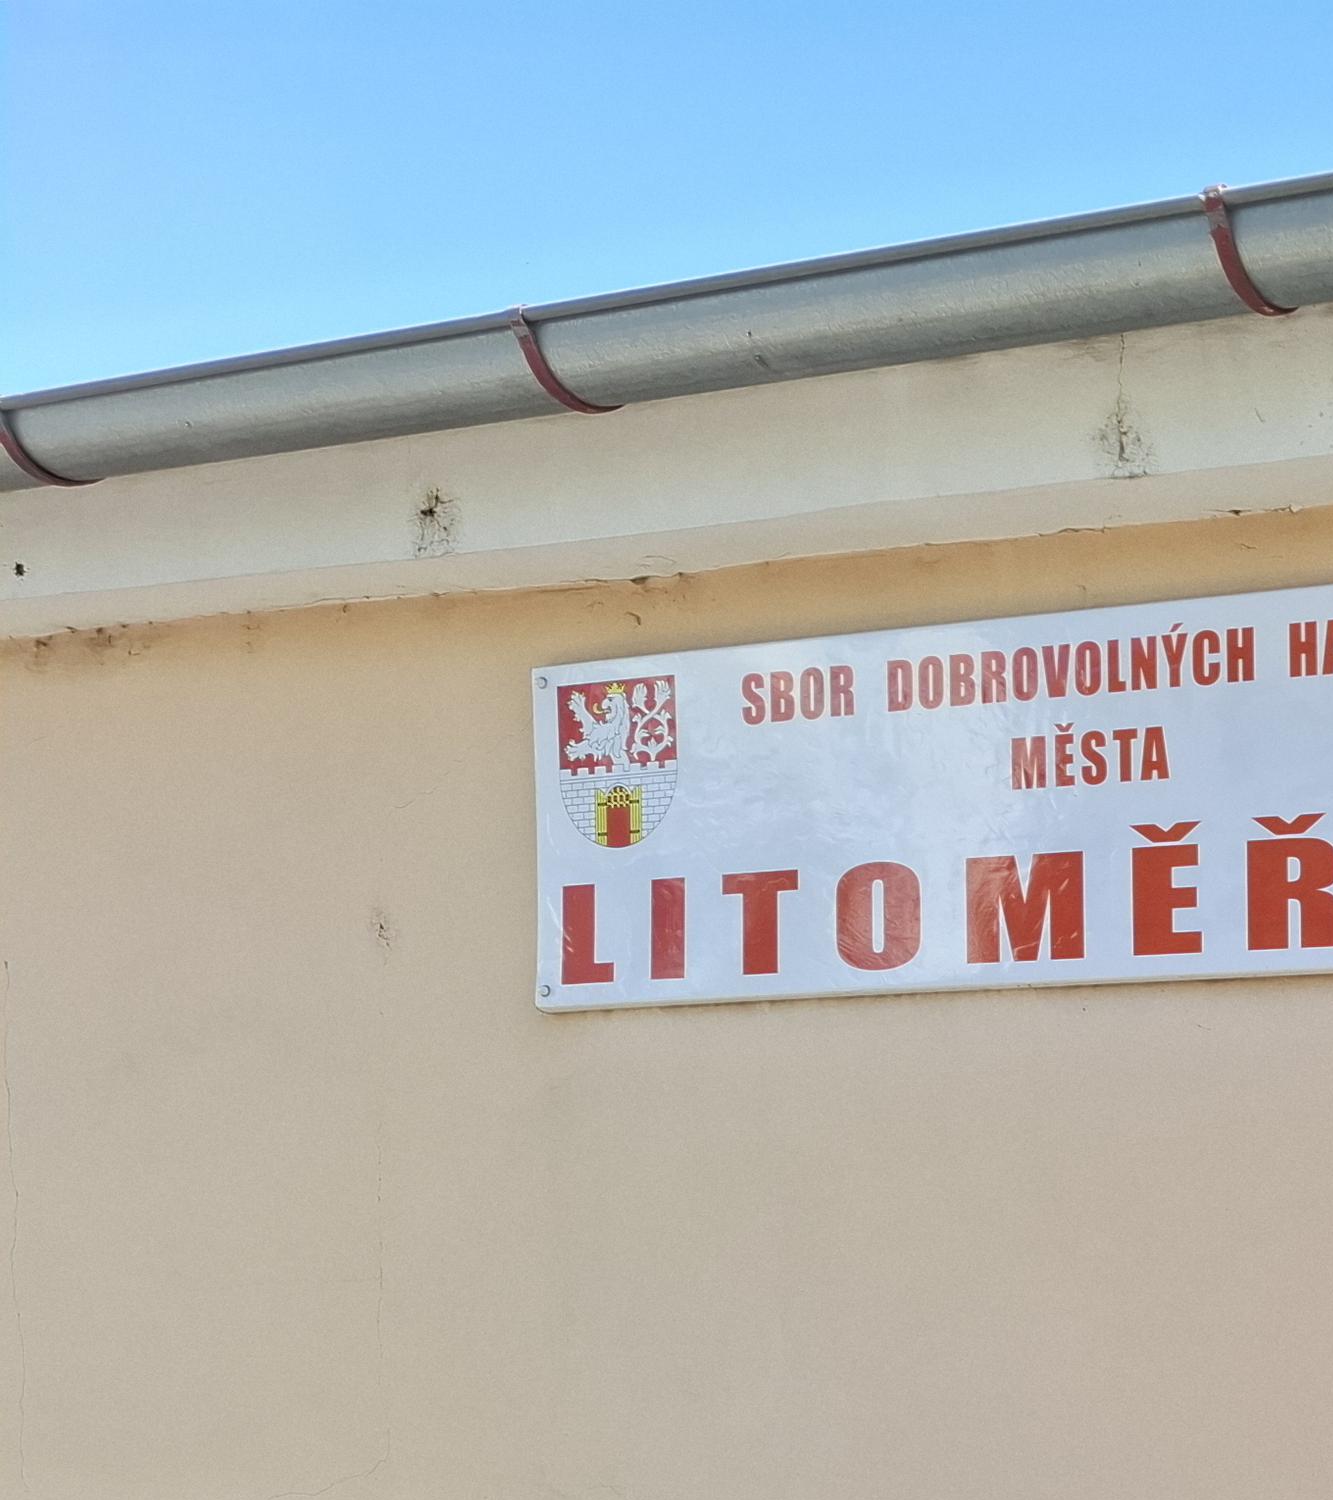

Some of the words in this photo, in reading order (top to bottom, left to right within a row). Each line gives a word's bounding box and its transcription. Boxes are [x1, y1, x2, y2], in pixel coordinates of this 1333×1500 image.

[741, 664, 855, 726] SBOR
[886, 622, 1255, 712] DOBROVOLNÝCH
[1011, 722, 1170, 791] MĚSTA
